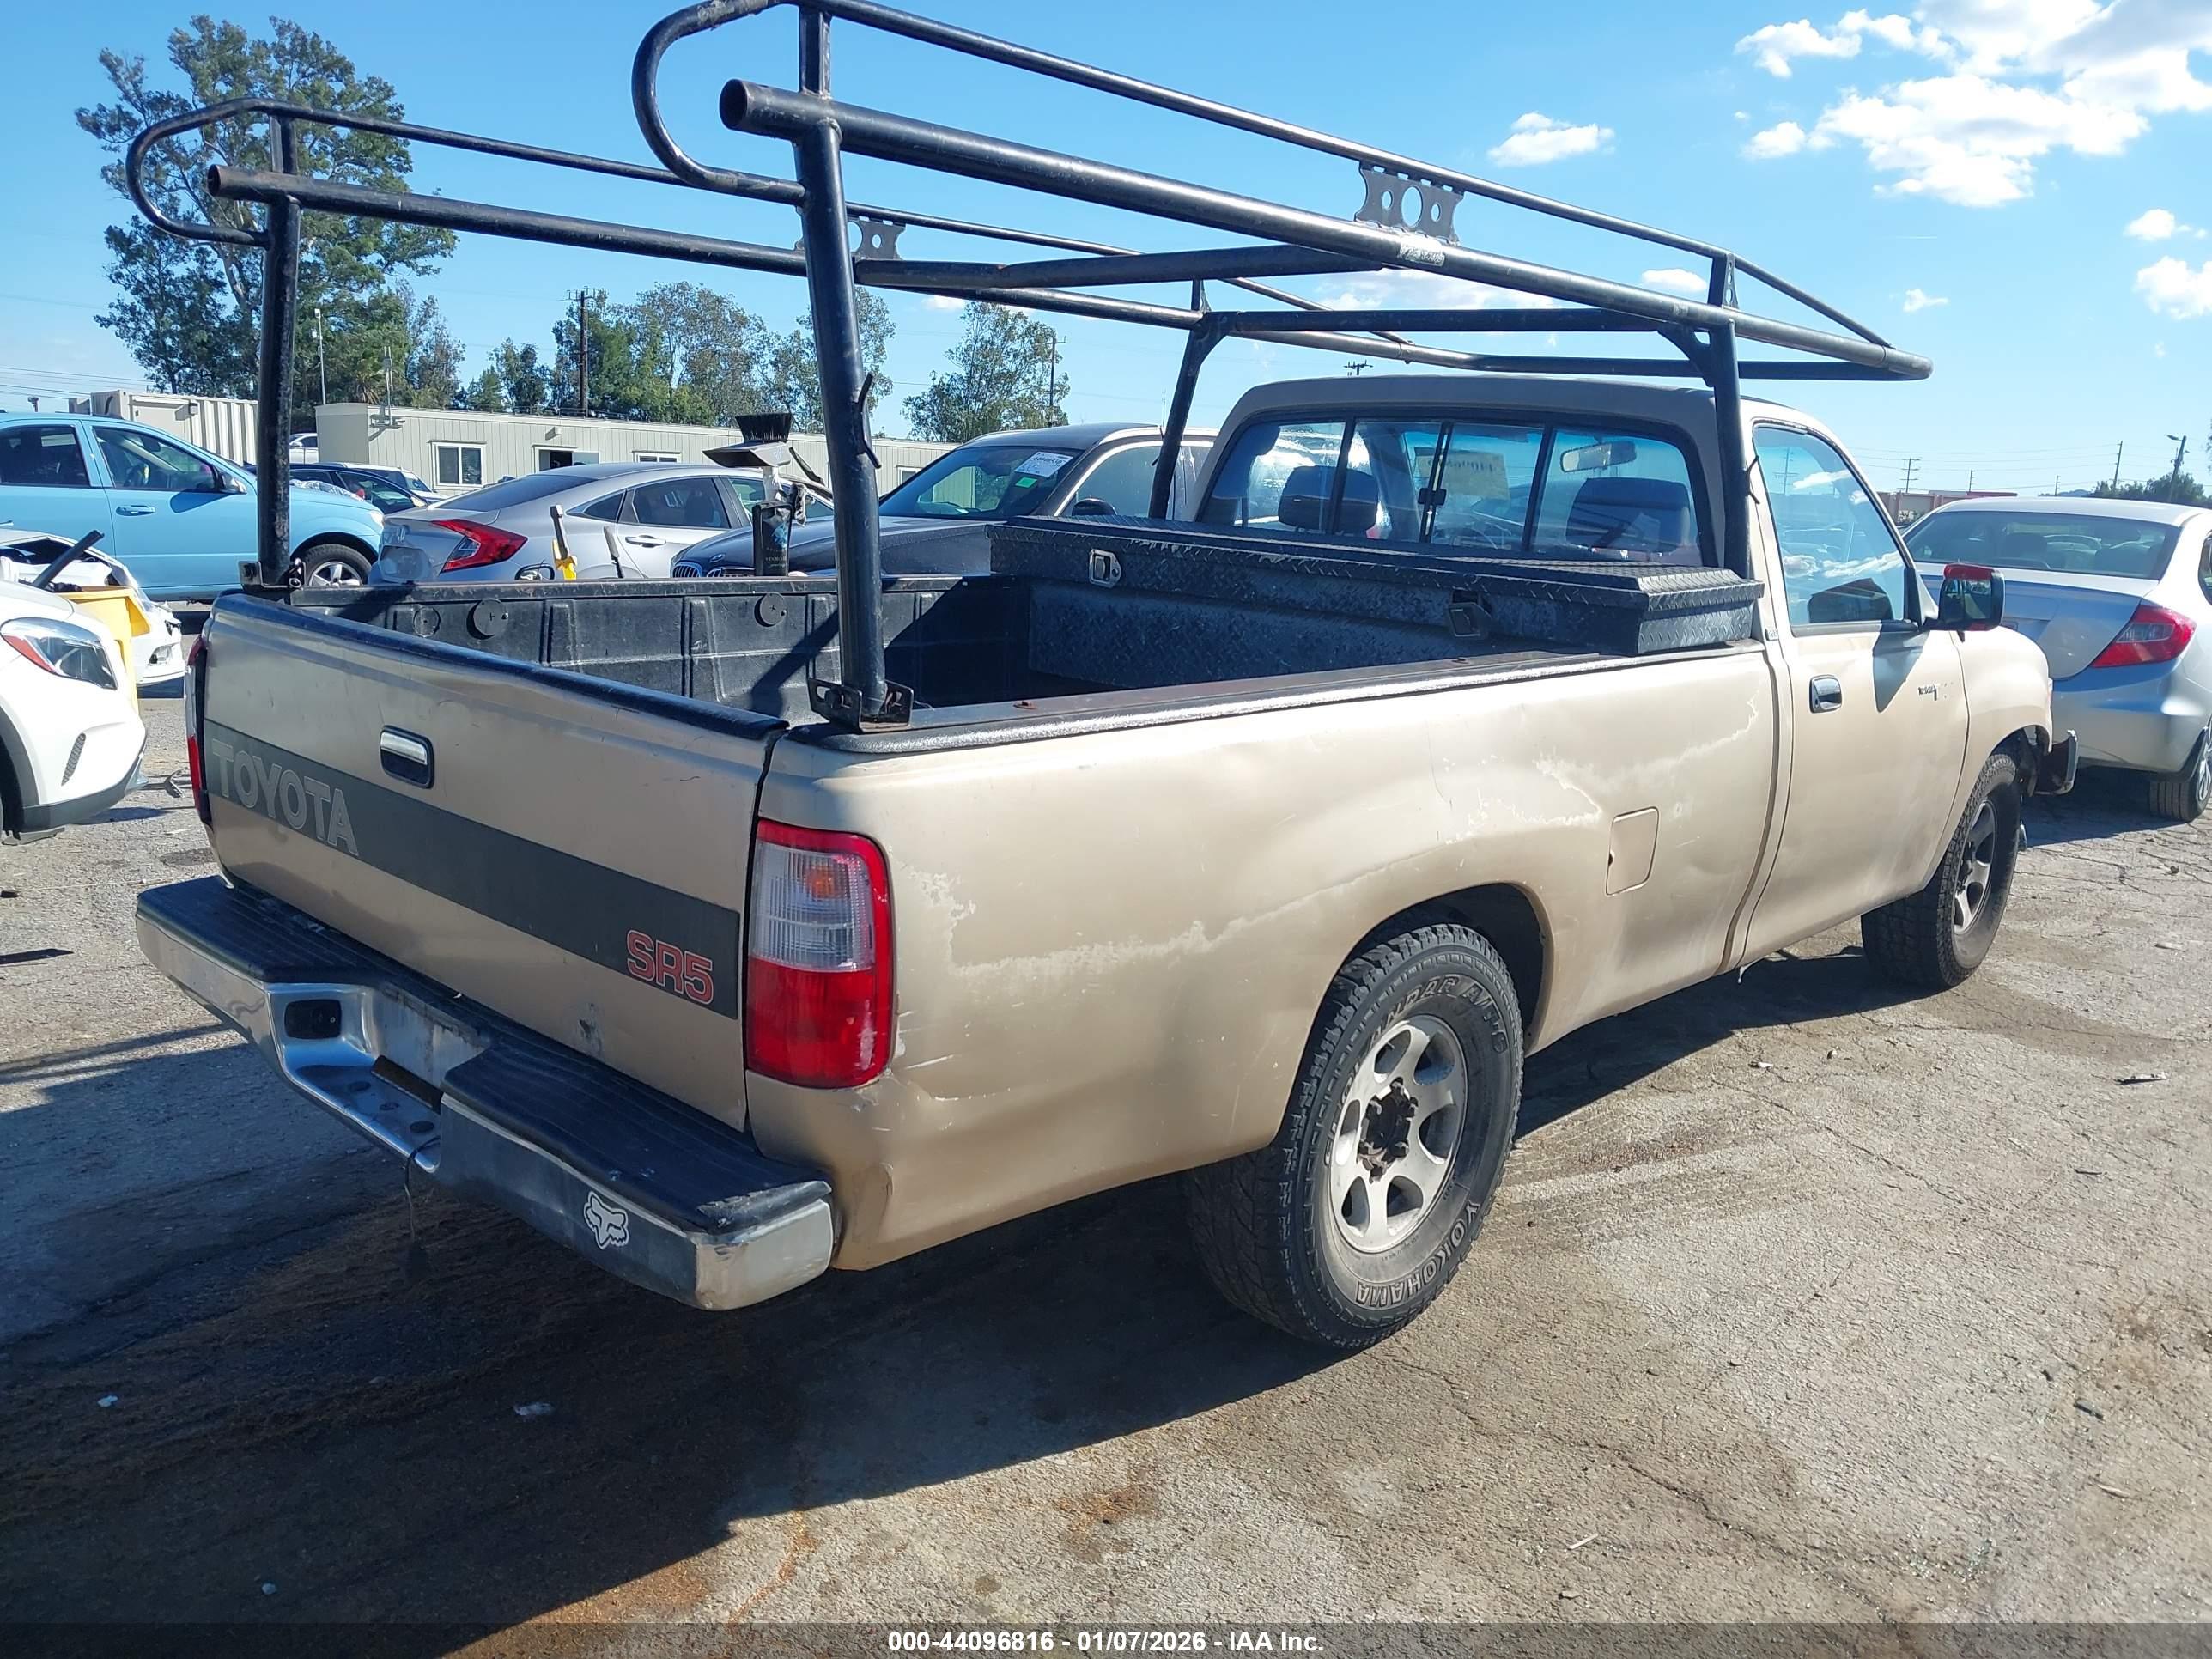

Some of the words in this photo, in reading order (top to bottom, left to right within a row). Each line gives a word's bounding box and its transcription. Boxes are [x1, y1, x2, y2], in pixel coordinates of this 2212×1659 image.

[212, 738, 359, 856] TOYOTA
[627, 929, 714, 1005] SR5
[1355, 1199, 1481, 1308] YOKOHAMA
